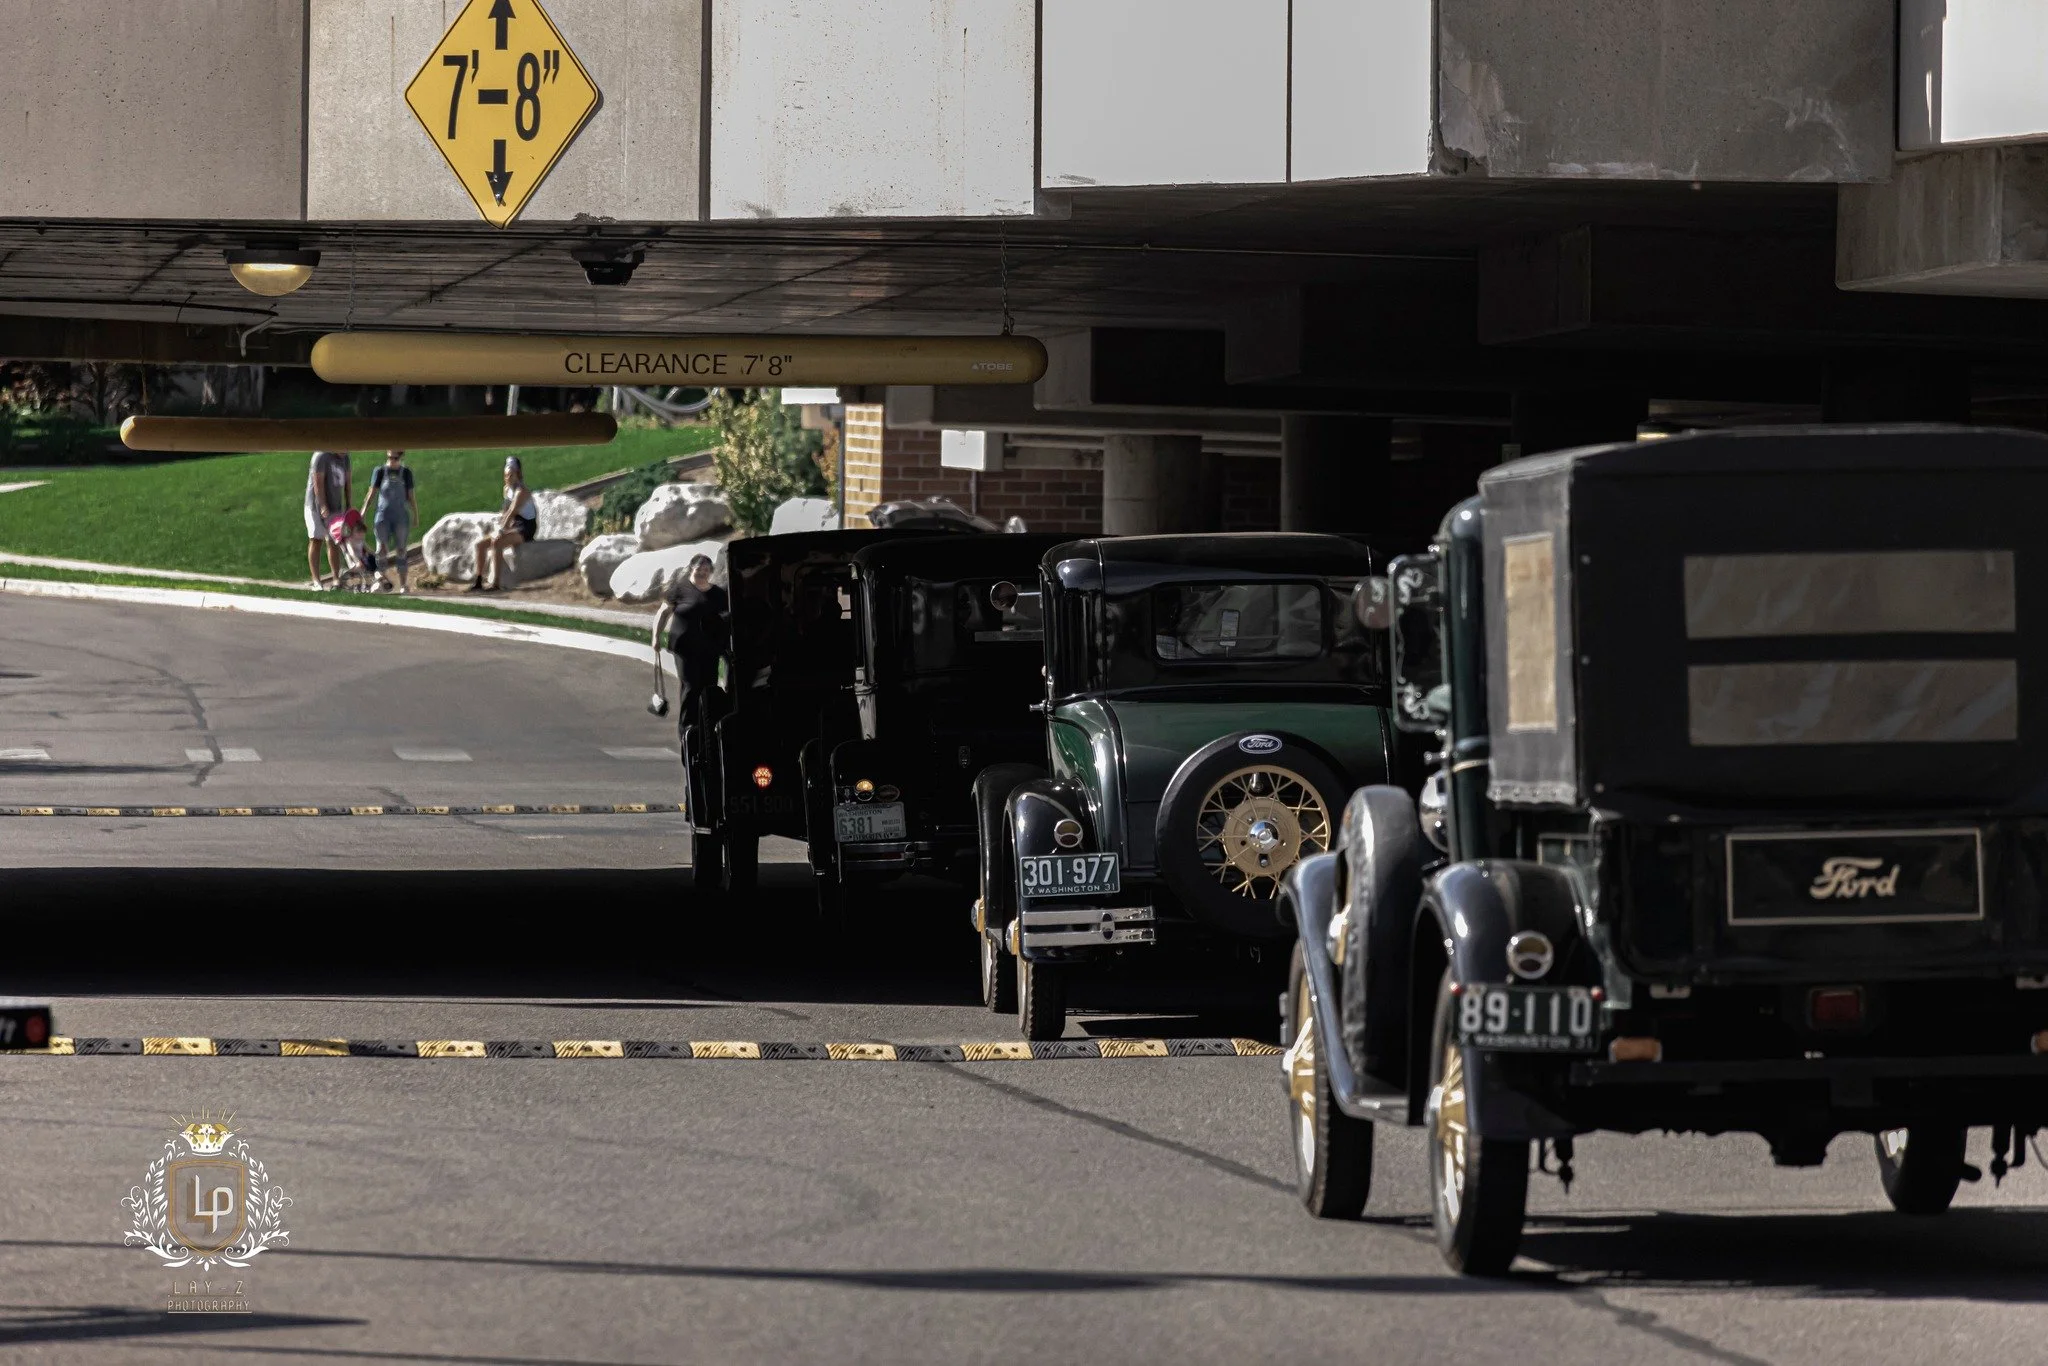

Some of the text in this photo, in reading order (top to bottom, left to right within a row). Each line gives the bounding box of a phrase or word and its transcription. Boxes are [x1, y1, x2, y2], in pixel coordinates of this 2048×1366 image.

[564, 352, 732, 375] CLEARANCE
[1247, 737, 1274, 748] Ford
[838, 816, 873, 836] 6381
[1809, 856, 1900, 899] Ford
[1027, 882, 1115, 894] X WASHINGTON 31
